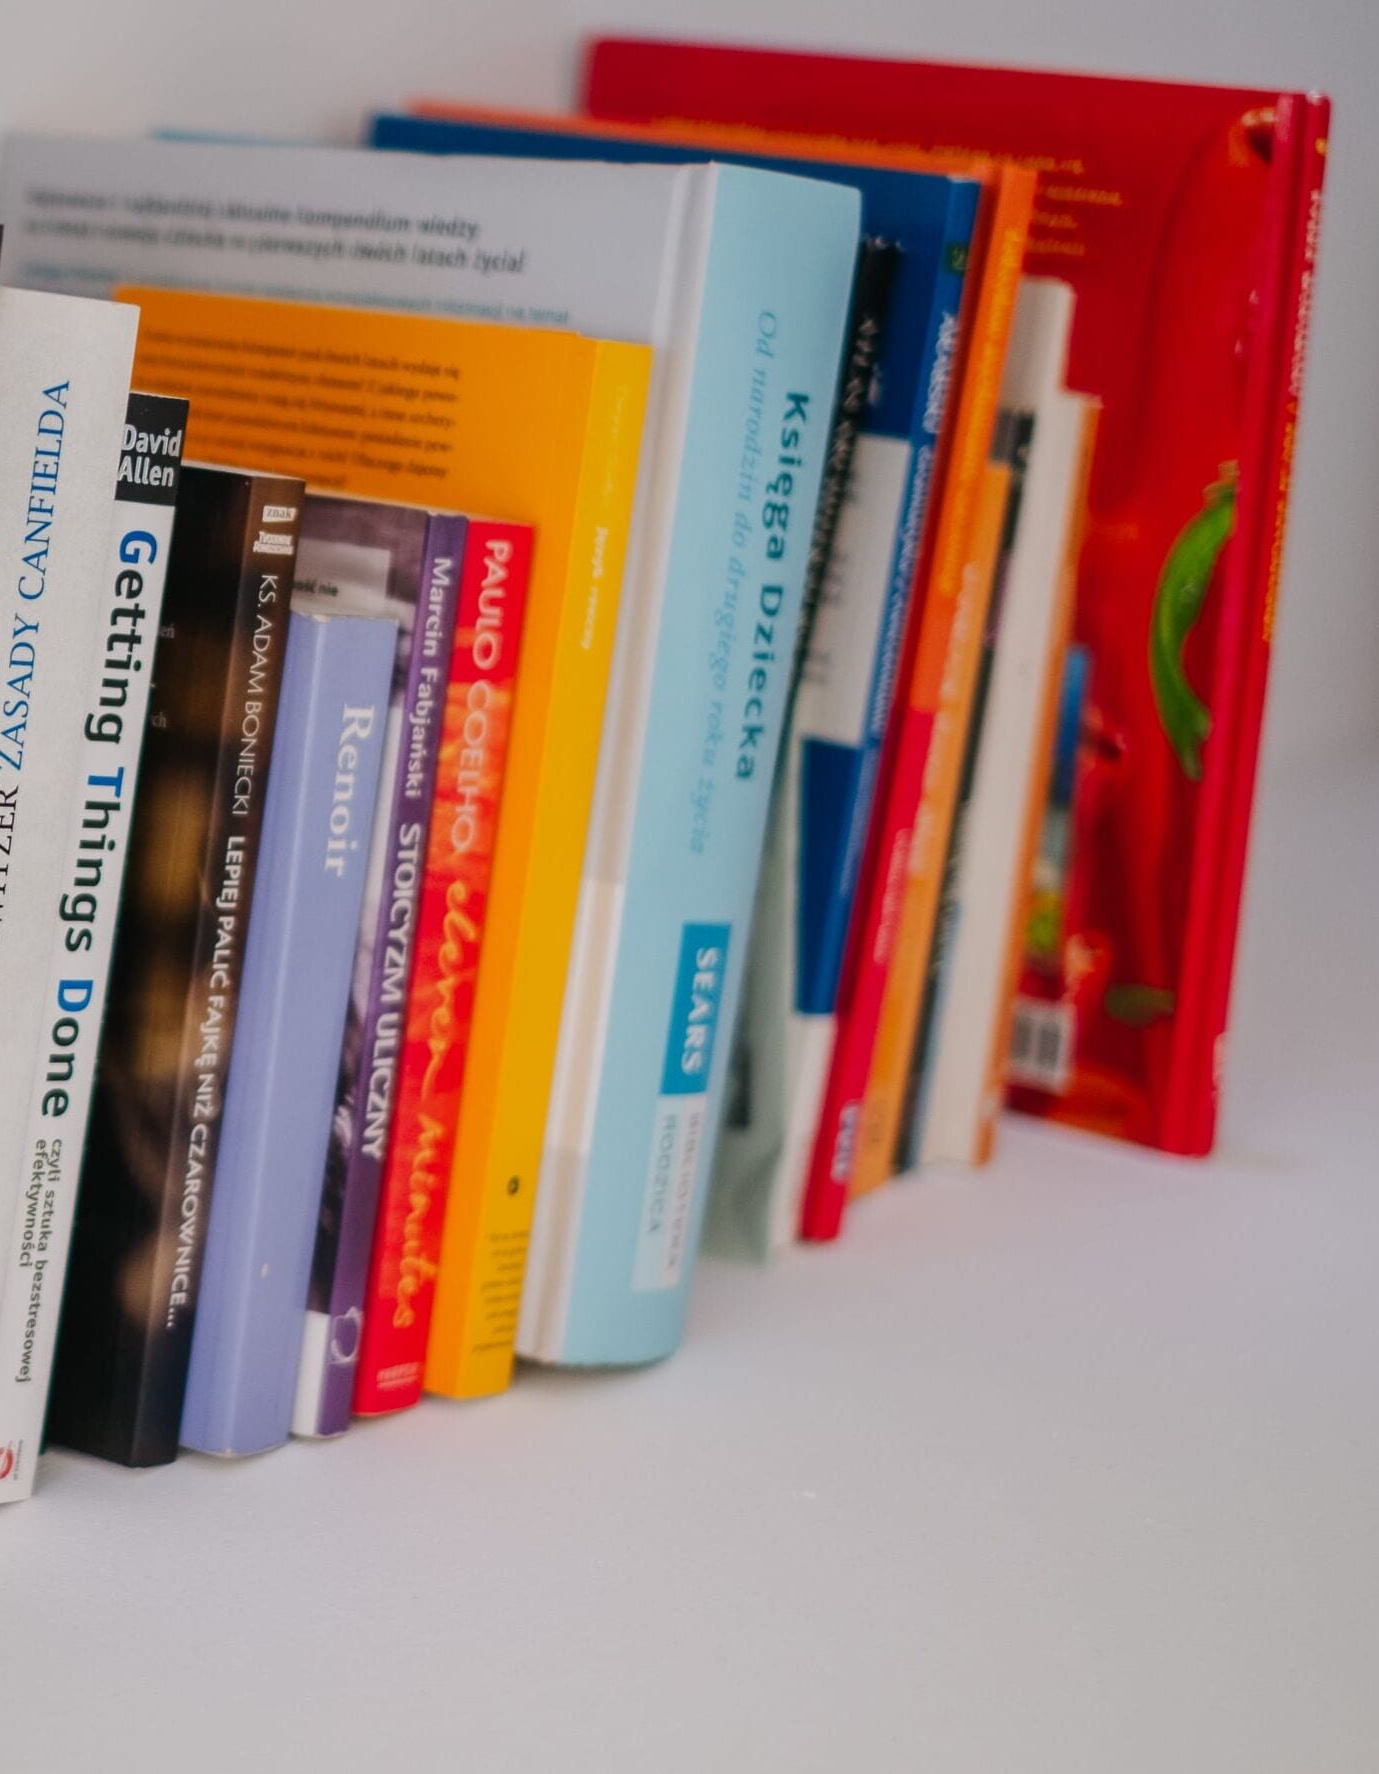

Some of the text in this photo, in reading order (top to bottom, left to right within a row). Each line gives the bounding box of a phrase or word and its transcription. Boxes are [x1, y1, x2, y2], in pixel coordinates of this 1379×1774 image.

[753, 309, 778, 360] Od
[17, 379, 71, 601] CANFIELDA
[118, 455, 175, 488] Allen
[120, 423, 183, 458] David
[732, 365, 767, 501] narodzin
[730, 509, 753, 549] do
[734, 390, 811, 782] Księga Dziecka
[256, 573, 279, 608] KS.
[471, 538, 513, 671] PAULO
[246, 613, 274, 694] ADAM
[231, 700, 263, 816] BONIECKI
[324, 702, 376, 878] Renoir
[450, 678, 493, 856] COELHO
[41, 529, 159, 1118] Getting Things Done
[215, 835, 246, 908] LEPIEJ
[360, 556, 453, 1164] Marcin Fabjański STOICYZM ULICZNY
[209, 916, 235, 989] PALIĆ
[681, 946, 722, 1075] SEARS
[194, 990, 226, 1068] FAJKĘ
[192, 1072, 218, 1123] NIŻ
[15, 1138, 63, 1383] czyli sztuka bezstresowej
[19, 1139, 47, 1268] efektywności
